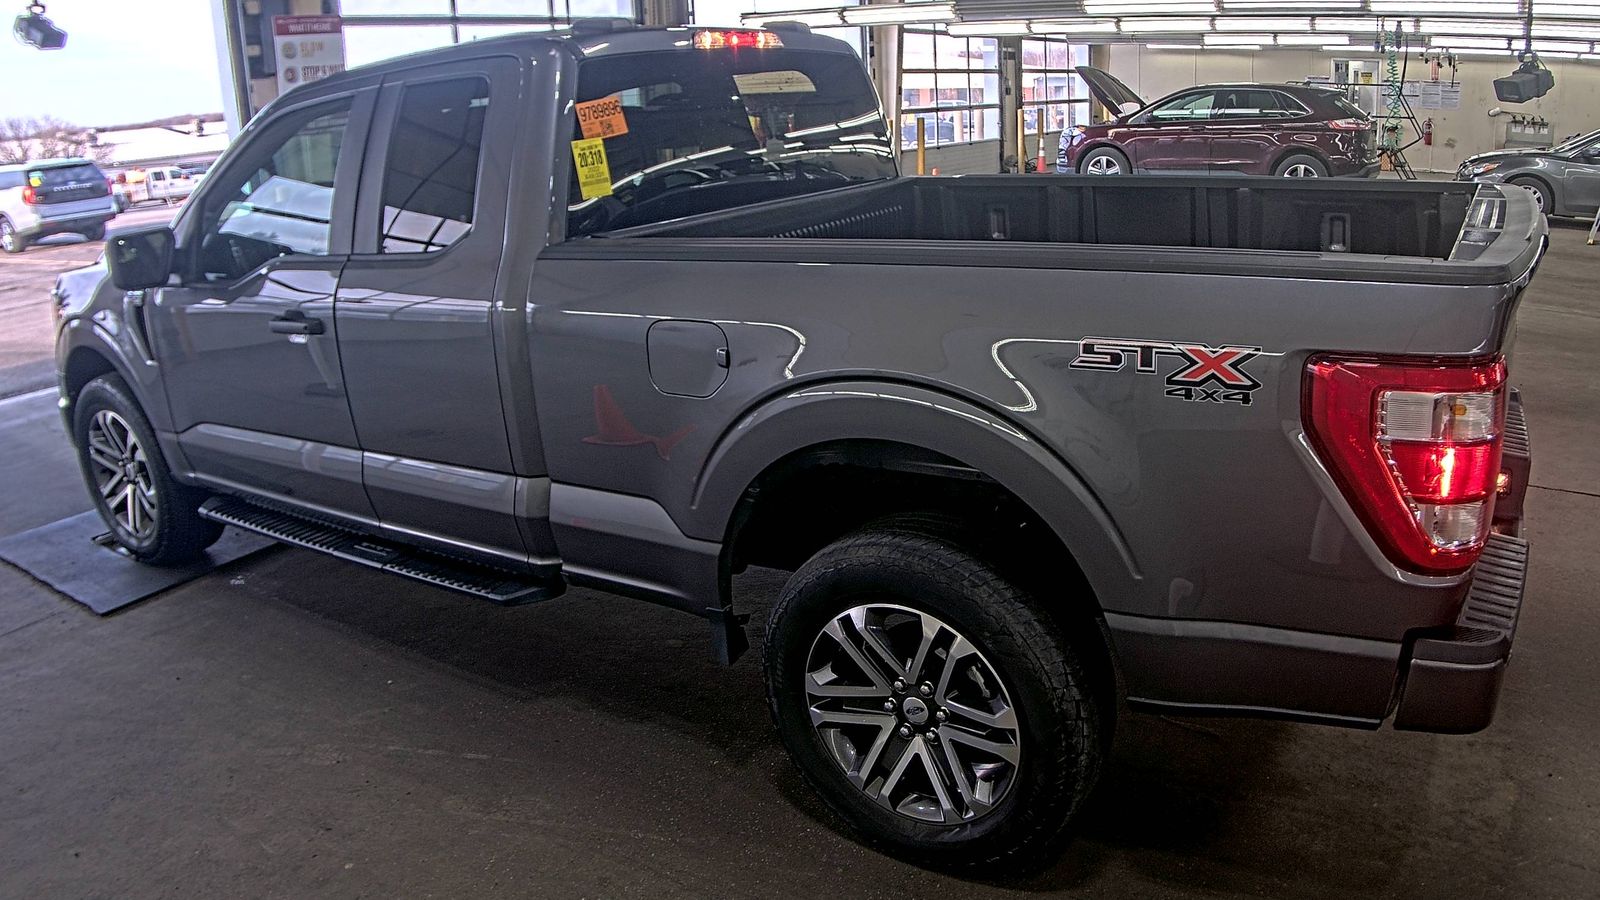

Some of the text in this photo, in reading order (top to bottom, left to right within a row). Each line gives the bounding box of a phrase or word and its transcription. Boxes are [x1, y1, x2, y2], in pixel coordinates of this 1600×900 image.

[302, 65, 320, 77] STOP
[579, 100, 622, 122] 9789896
[1069, 336, 1262, 391] STX
